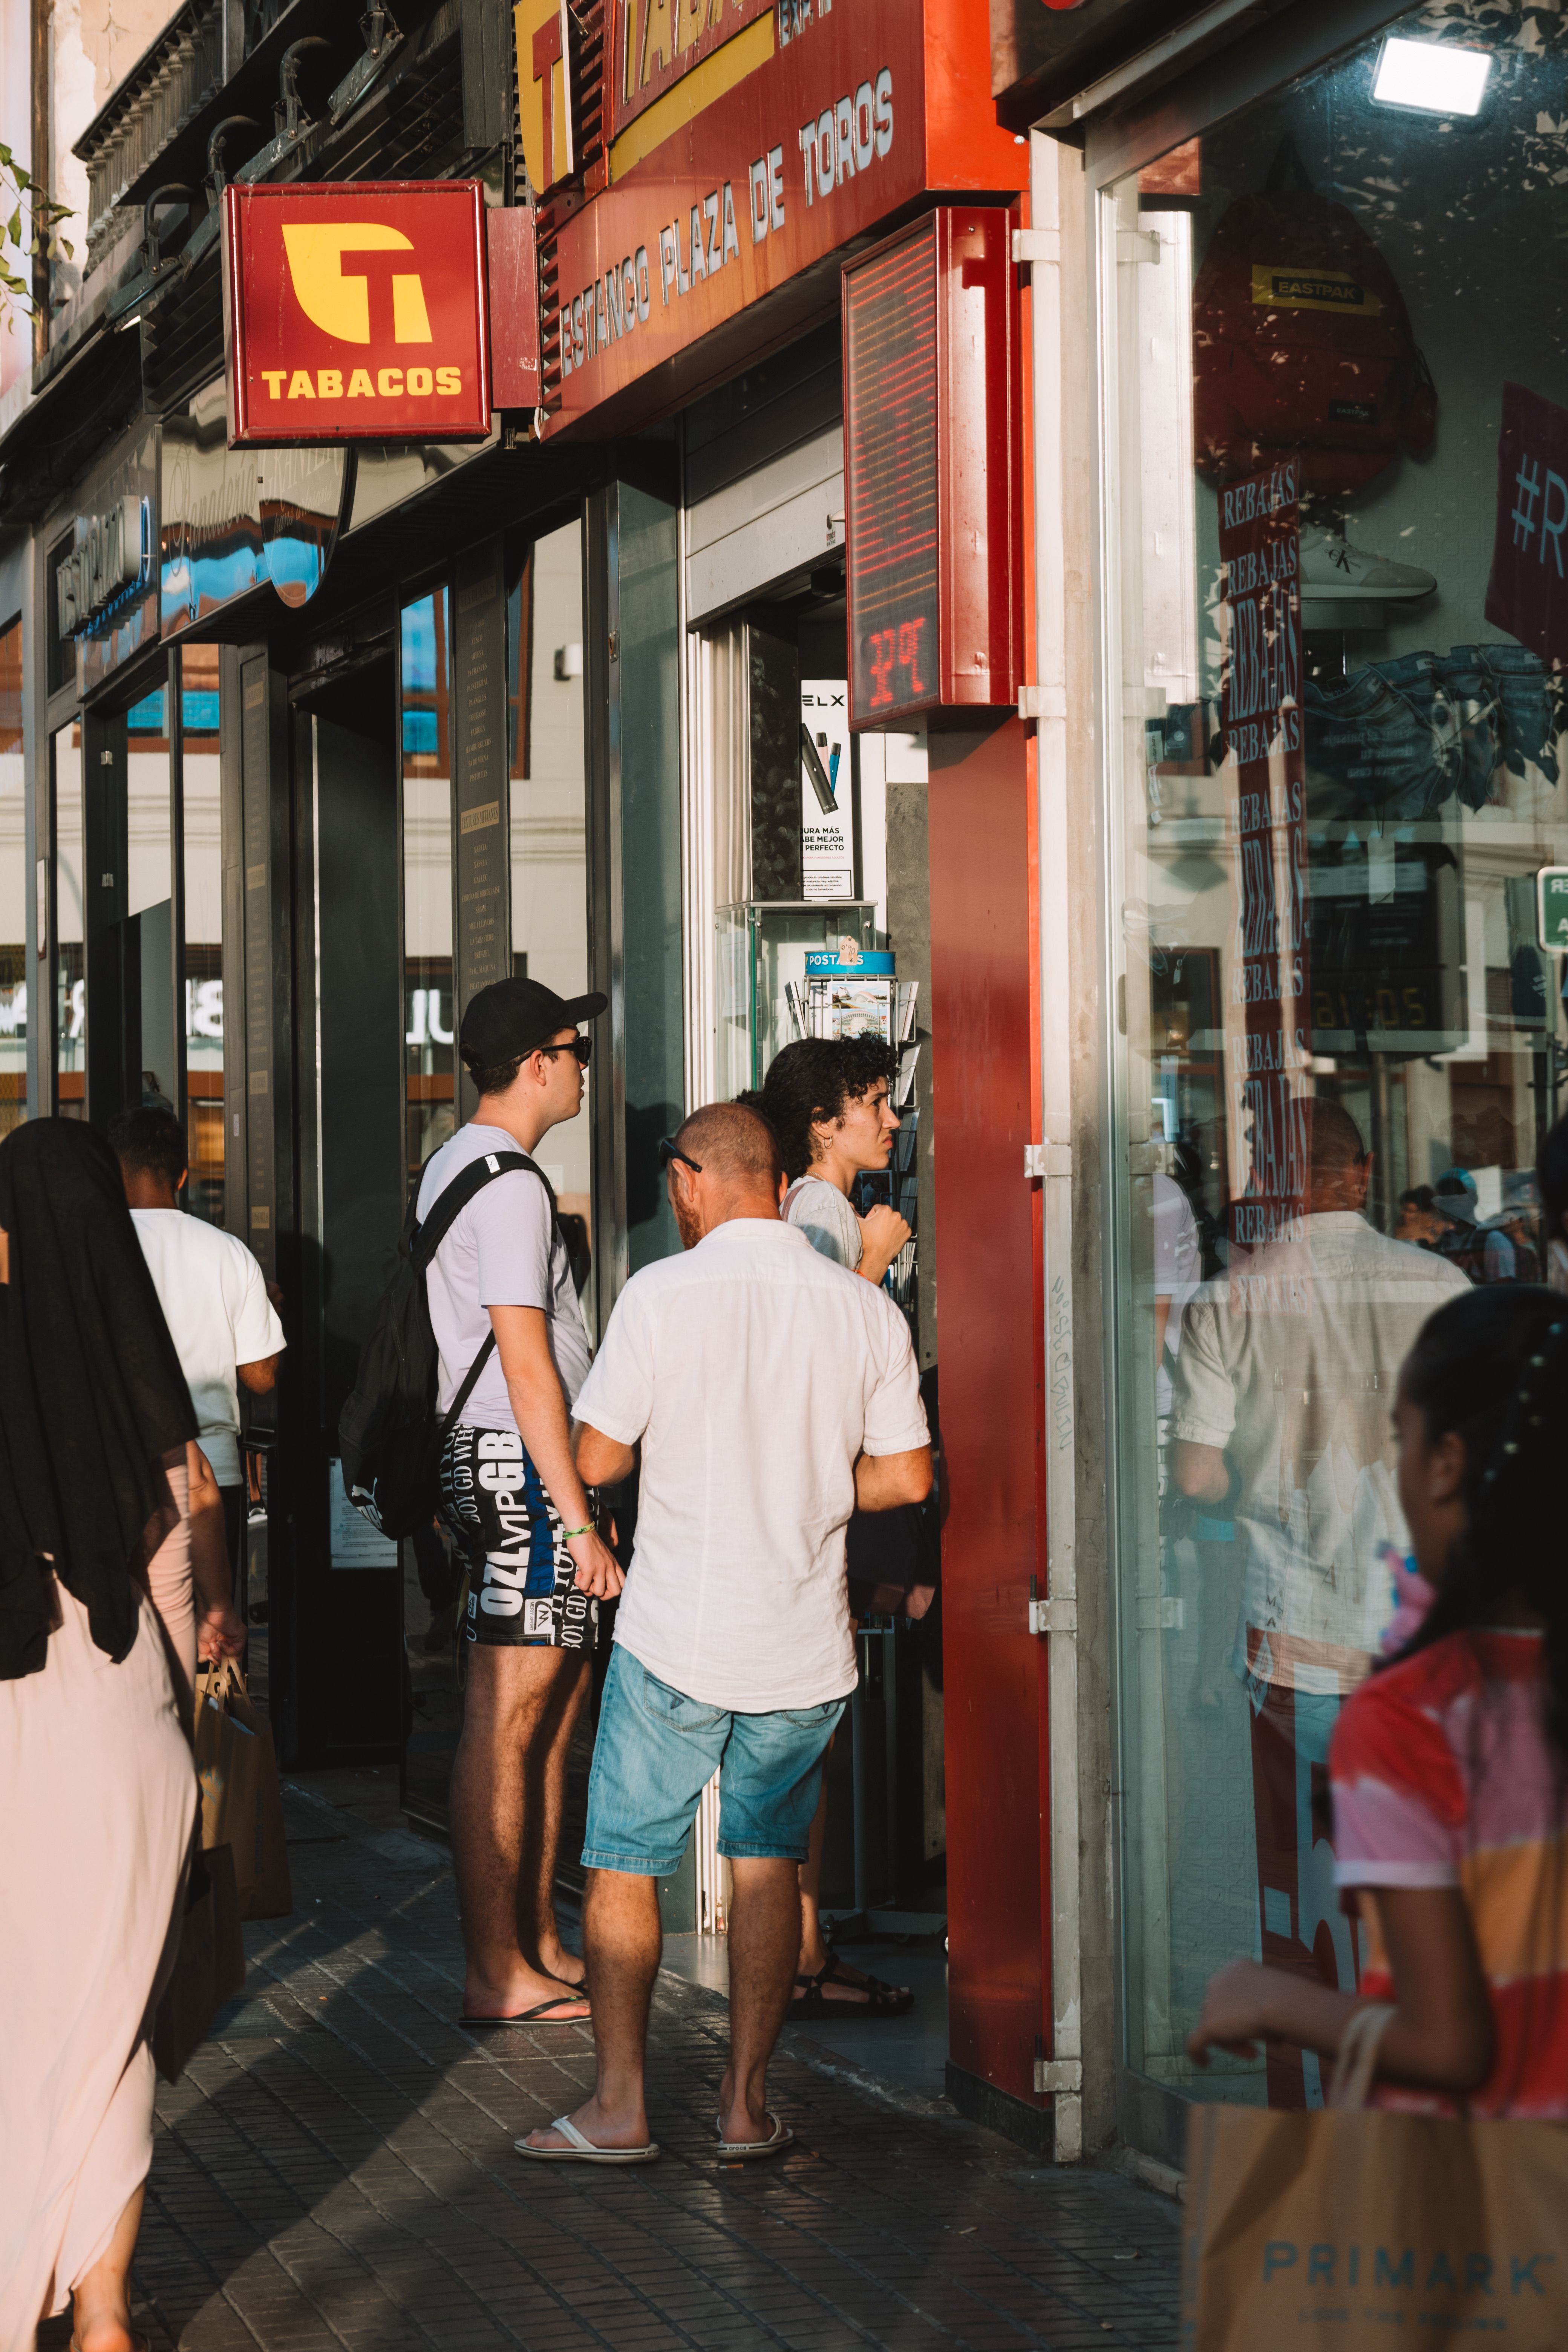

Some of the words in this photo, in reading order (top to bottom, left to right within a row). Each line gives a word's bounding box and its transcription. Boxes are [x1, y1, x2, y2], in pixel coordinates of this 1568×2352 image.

[560, 245, 648, 377] ESTANCO
[661, 181, 739, 306] PLAZA
[749, 143, 785, 244] DE
[799, 67, 893, 207] TOROS
[1278, 282, 1355, 299] EASTPAK
[262, 367, 461, 400] TABACOS
[1337, 407, 1370, 416] EASTPAK
[1224, 464, 1295, 530] REBAJAS
[1226, 535, 1296, 597] REBAJAS
[1227, 579, 1298, 721] REBAJAS
[466, 738, 492, 754] HAMBURGUERS
[470, 725, 485, 737] FABIOLA
[1227, 710, 1300, 767] REBAJAS
[470, 769, 488, 782] PISTOLETS
[478, 754, 489, 764] VIENA
[462, 813, 479, 829] TEXTURES
[479, 806, 498, 824] MITJANES
[1231, 782, 1302, 836] REBAJAS
[462, 893, 475, 902] CORONA
[1233, 826, 1302, 959] REBAJAS
[810, 955, 864, 966] POSTS
[1232, 956, 1303, 1005] REBAJAS
[1232, 1028, 1306, 1073] REBAJAS
[1234, 1072, 1307, 1197] REBAJAS
[1234, 1203, 1305, 1243] REBAJAS
[454, 1465, 474, 1493] GD
[456, 1495, 481, 1524] BOY
[565, 1595, 587, 1619] GD
[1263, 2241, 1547, 2295] PRIMARK
